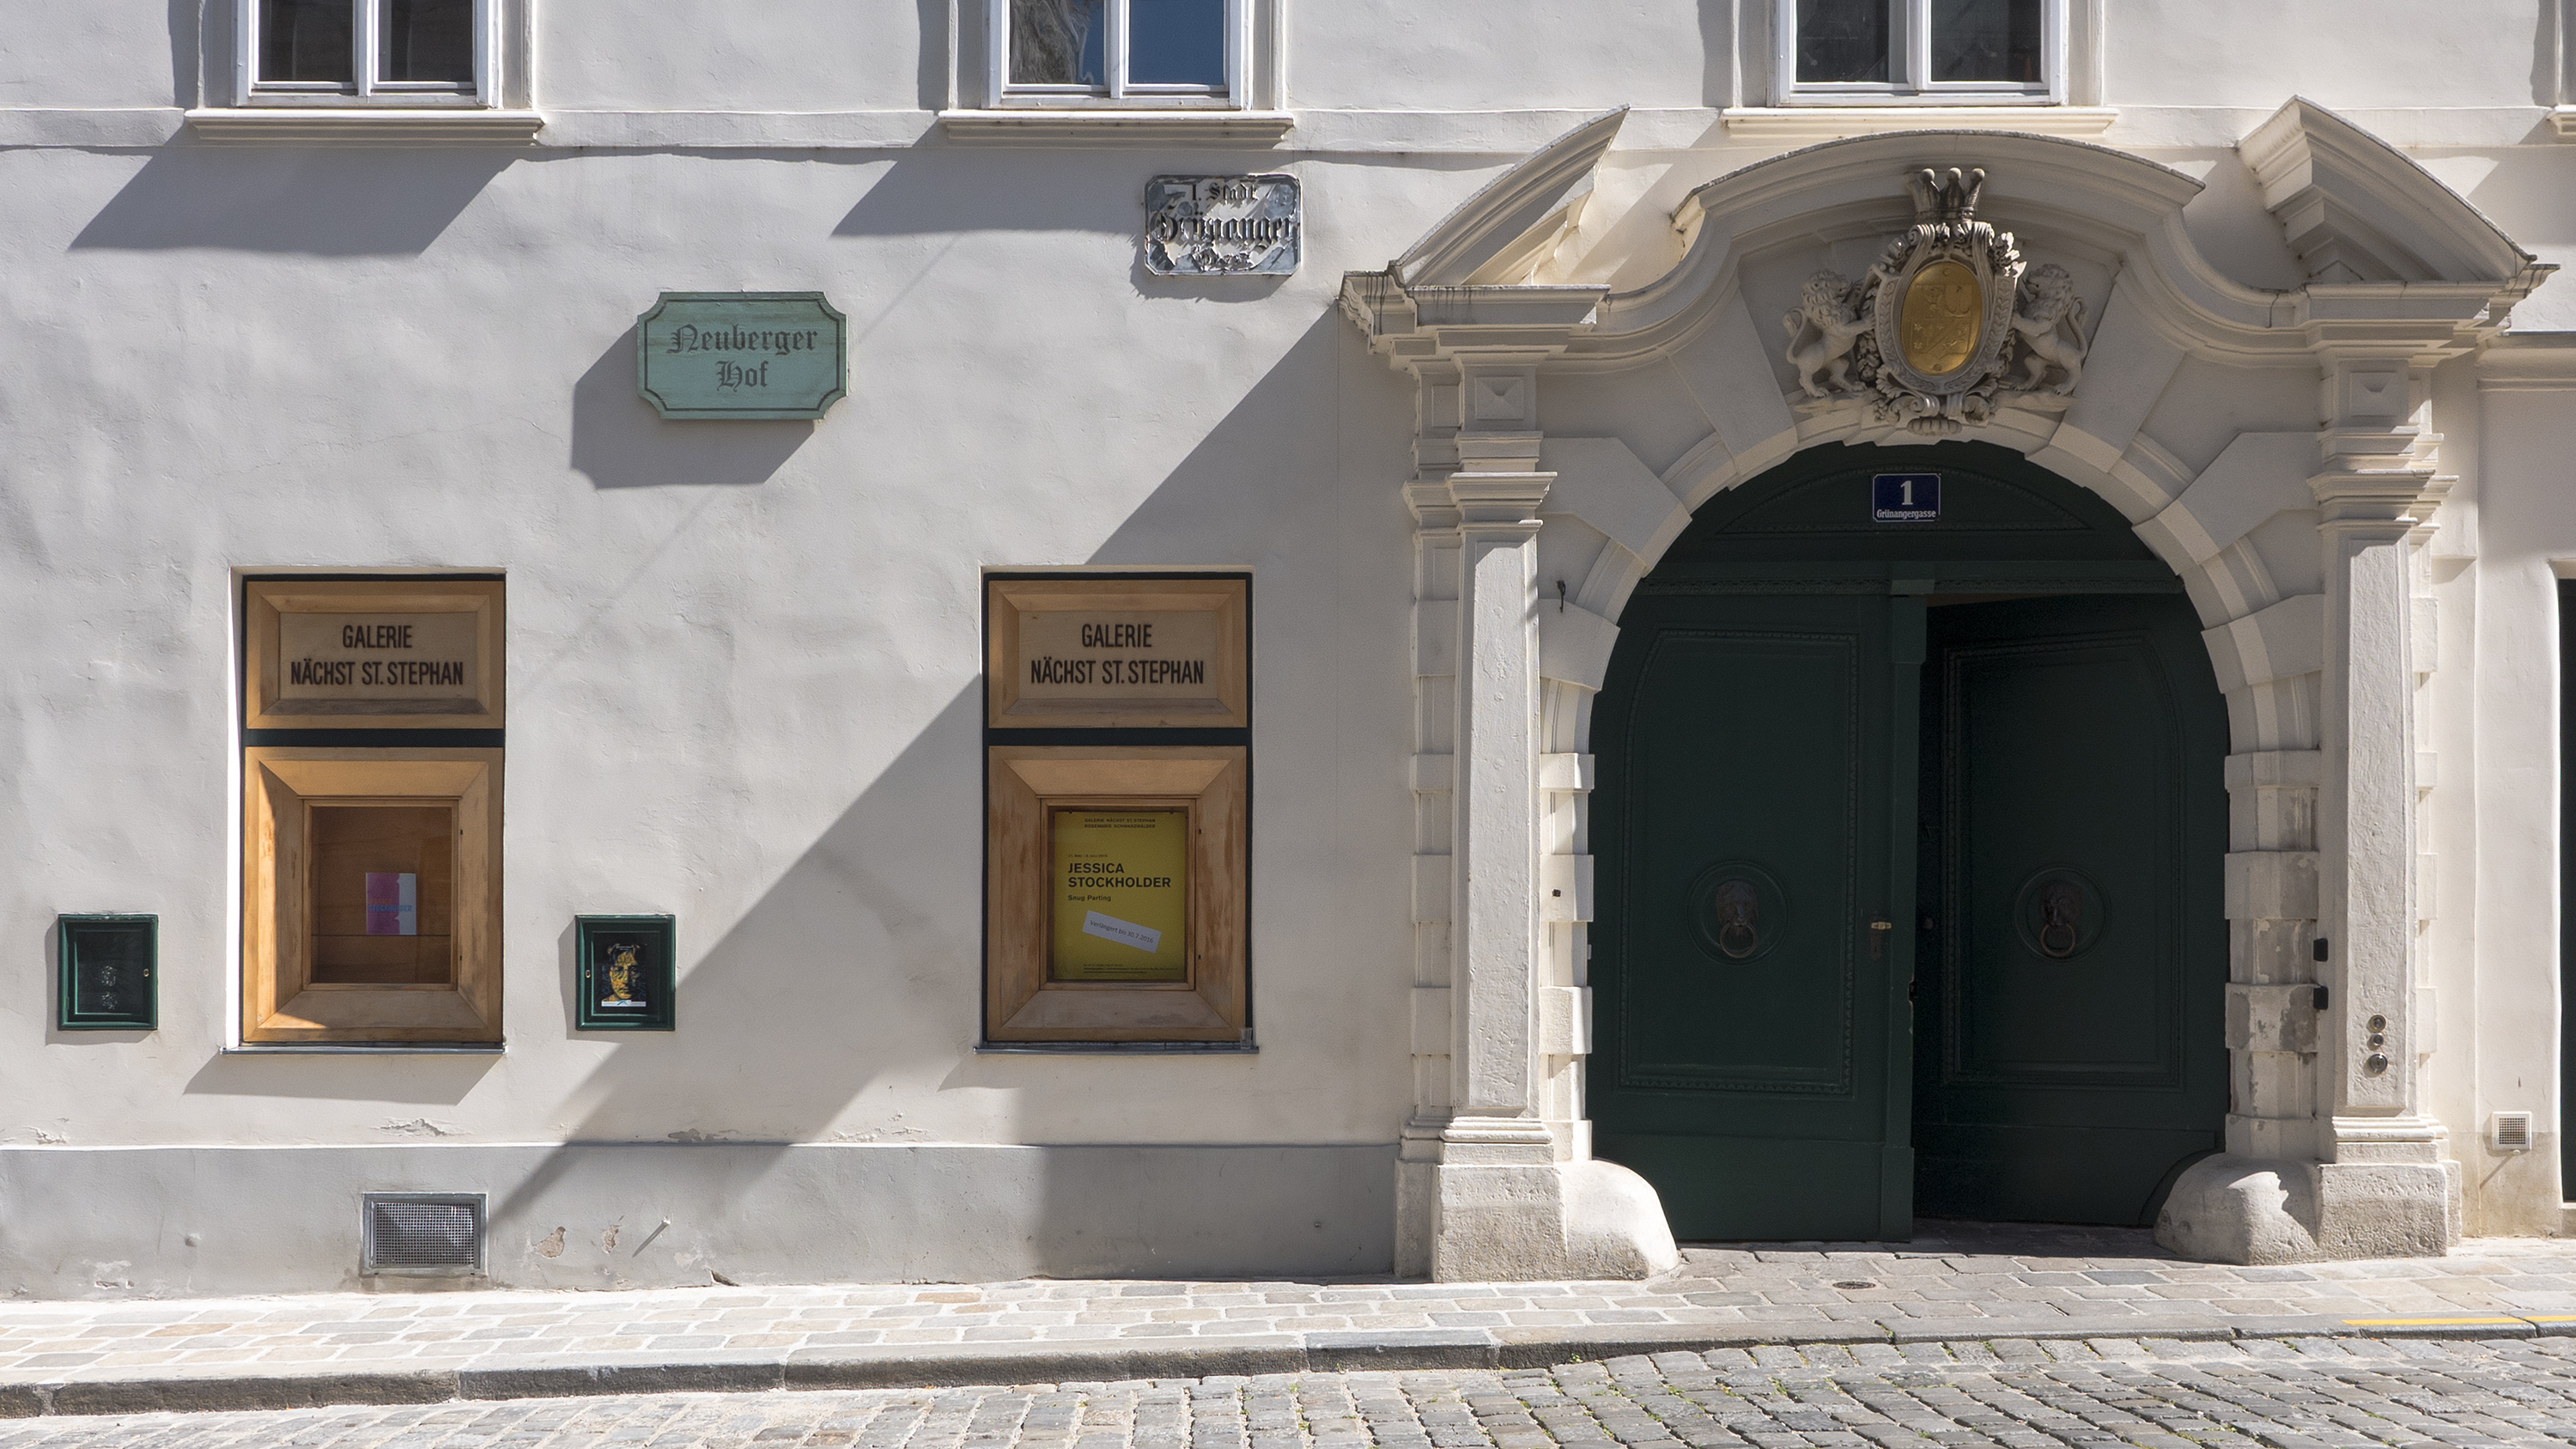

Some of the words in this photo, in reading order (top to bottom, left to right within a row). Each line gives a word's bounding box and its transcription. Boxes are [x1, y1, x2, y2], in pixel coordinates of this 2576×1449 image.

[666, 324, 818, 356] Neuberger
[715, 360, 769, 393] Hof
[1900, 480, 1913, 505] 1
[1876, 508, 1936, 520] Grünangergasse
[343, 625, 413, 648] GALERIE
[1081, 624, 1152, 648] GALERIE
[290, 658, 355, 685] NÄCHST
[1030, 656, 1097, 685] NÄCHST
[1067, 862, 1125, 874] JESSICA
[1068, 877, 1171, 888] STOCKHOLDER
[1090, 920, 1118, 933] Verlängert
[1127, 930, 1154, 944] 30.7.2016
